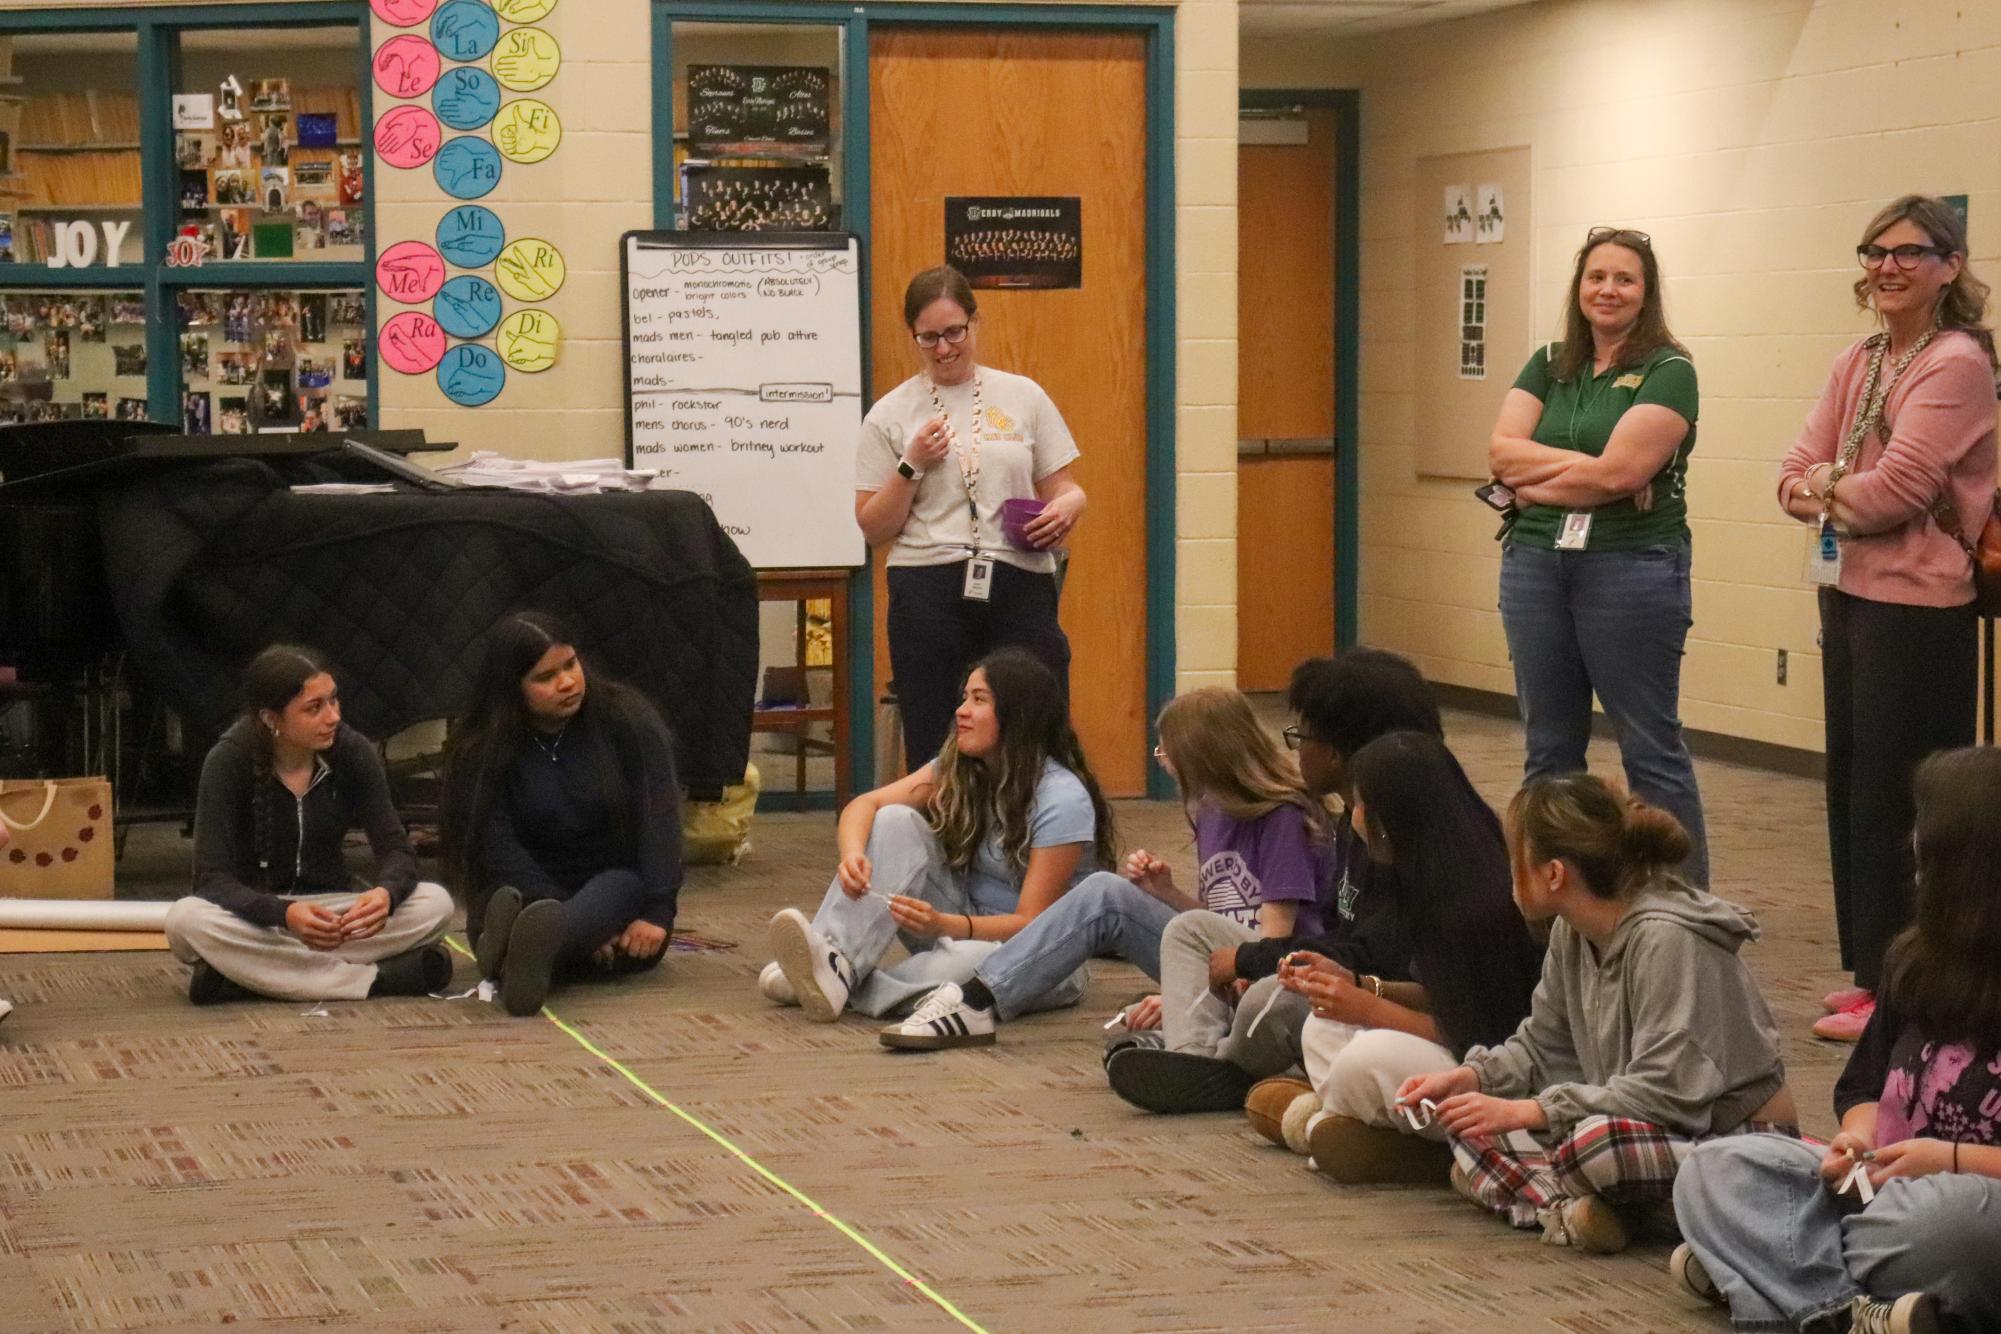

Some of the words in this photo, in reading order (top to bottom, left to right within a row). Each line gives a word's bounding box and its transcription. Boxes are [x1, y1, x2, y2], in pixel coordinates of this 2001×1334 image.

[454, 36, 478, 55] La
[509, 32, 527, 53] Si
[398, 72, 420, 92] Le
[455, 69, 480, 90] So
[528, 108, 550, 129] Fi
[410, 138, 432, 159] Se
[472, 159, 495, 179] Fa
[457, 210, 482, 231] Mi
[47, 220, 131, 268] JOY
[166, 241, 210, 267] JOY
[534, 247, 554, 268] Ri
[388, 275, 418, 294] Me
[469, 282, 494, 301] Re
[632, 288, 669, 300] opener
[411, 318, 435, 338] Ra
[518, 313, 542, 334] Di
[633, 313, 652, 324] bel
[632, 331, 663, 342] mads
[711, 329, 753, 346] tangled
[760, 331, 781, 344] pub
[788, 331, 819, 340] attire
[459, 348, 487, 368] Do
[672, 400, 722, 410] rockstar
[635, 420, 664, 429] mens
[760, 417, 789, 430] nerd
[636, 443, 666, 454] mads
[731, 439, 776, 459] britney
[780, 443, 824, 453] workout
